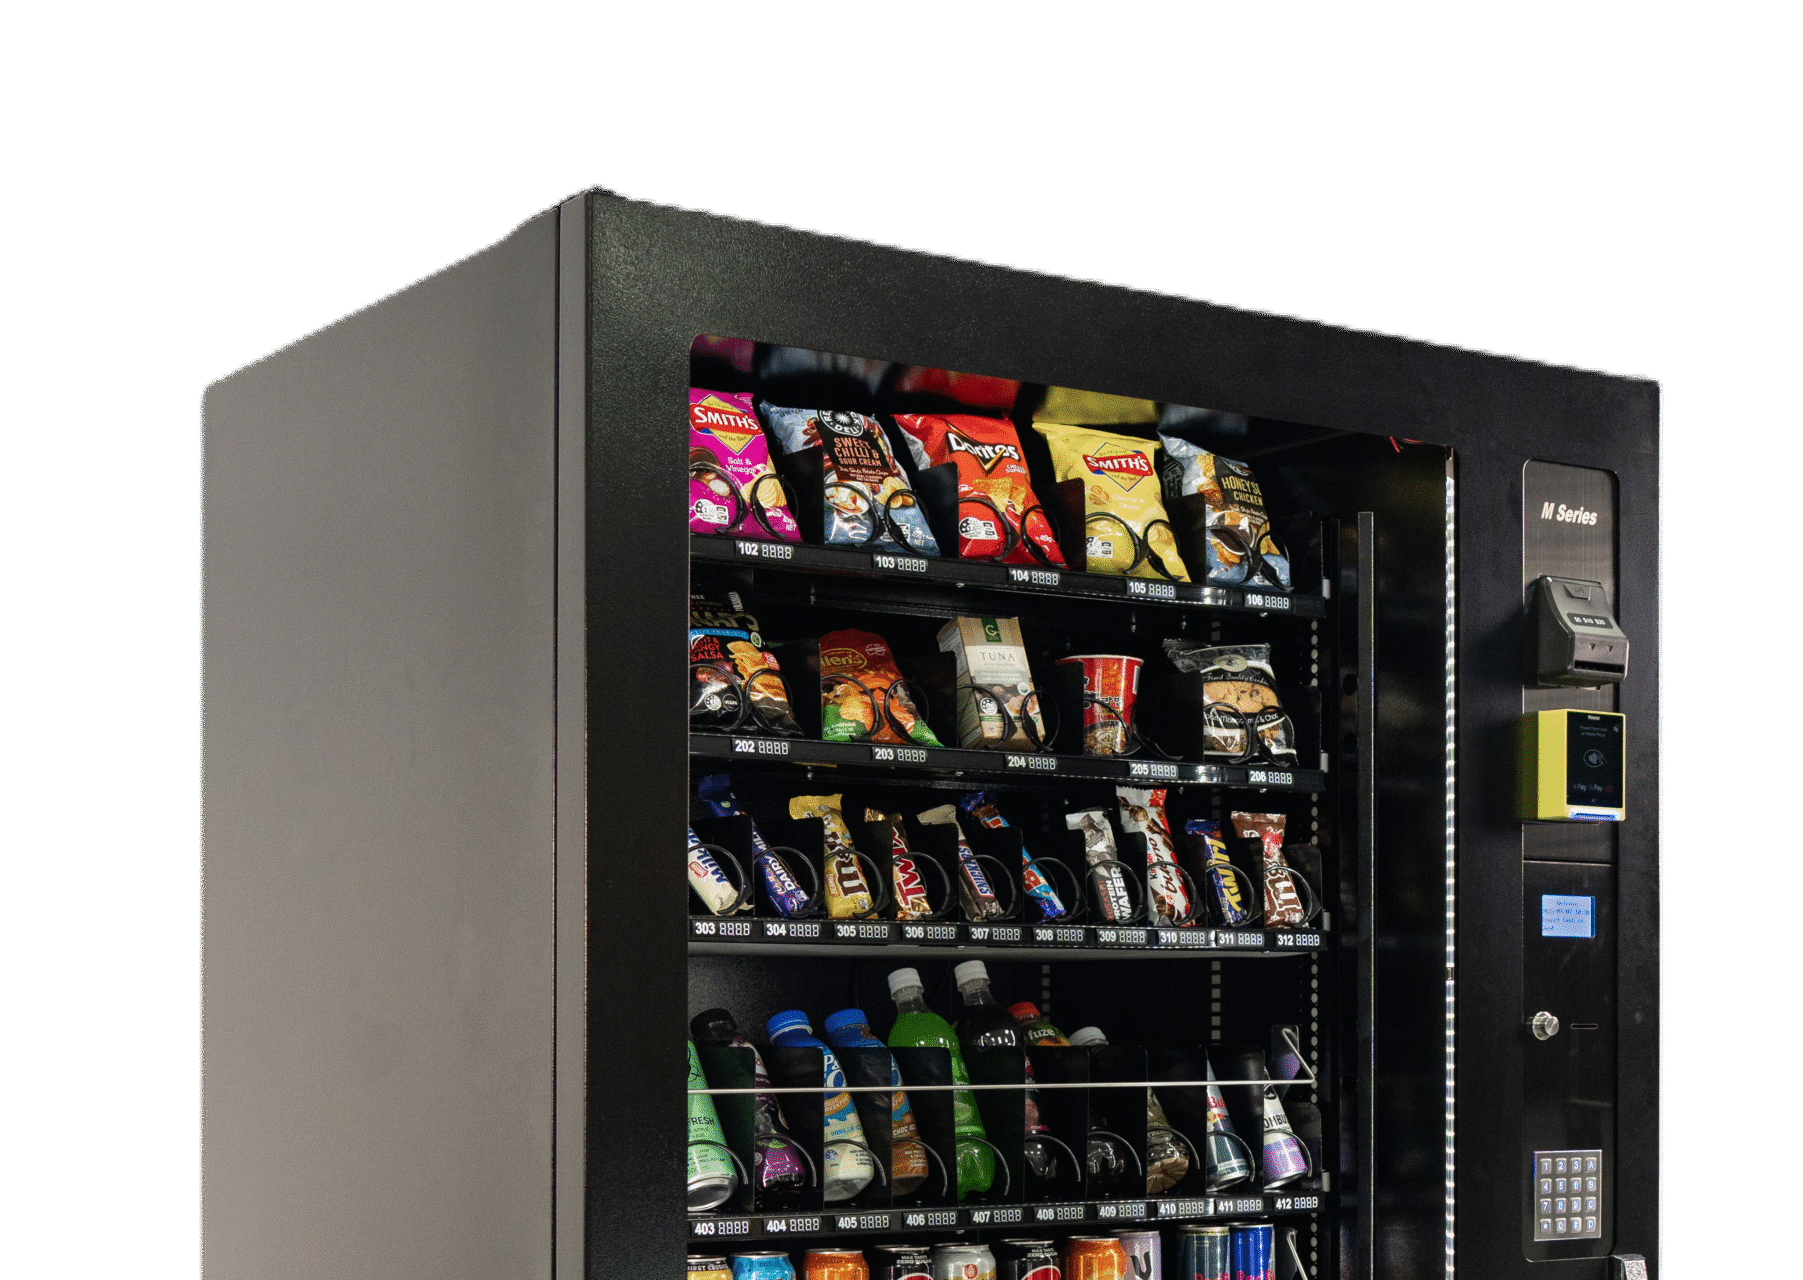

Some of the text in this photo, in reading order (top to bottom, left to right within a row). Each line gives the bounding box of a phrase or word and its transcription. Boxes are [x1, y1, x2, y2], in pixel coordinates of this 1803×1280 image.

[694, 407, 758, 430] SMITH'S
[833, 437, 871, 449] SWEET
[948, 432, 1020, 460] Doritos
[834, 447, 880, 459] CHILLI &
[838, 457, 882, 466] SOUR CREAM
[1087, 456, 1149, 471] SMITH'S
[1221, 475, 1251, 493] HONEY
[1233, 491, 1264, 506] CHICKEN
[1541, 501, 1598, 526] M Series
[739, 542, 758, 555] 102
[876, 556, 894, 568] 103
[1012, 570, 1029, 581] 104
[1129, 582, 1147, 594] 105
[1247, 595, 1263, 606] 106
[980, 652, 1016, 661] TUNA
[735, 740, 755, 752] 202
[875, 748, 894, 760] 203
[1008, 756, 1026, 767] 204
[1132, 764, 1149, 776] 205
[1250, 771, 1266, 782] 206
[764, 855, 796, 890] DAIRY
[1110, 864, 1132, 921] WAFER
[1105, 880, 1121, 920] PROTEIN
[696, 922, 715, 934] 303
[767, 924, 786, 935] 304
[837, 925, 856, 936] 305
[905, 927, 924, 938] 306
[972, 928, 989, 939] 307
[1036, 929, 1053, 940] 308
[1100, 931, 1116, 941] 309
[1160, 932, 1177, 942] 310
[1219, 934, 1234, 944] 311
[1278, 935, 1293, 945] 312
[1028, 1028, 1055, 1040] fuze
[1160, 1203, 1177, 1215] 410
[1219, 1201, 1233, 1211] 411
[1276, 1199, 1291, 1209] 412
[973, 1211, 990, 1222] 407
[1037, 1209, 1054, 1220] 408
[1100, 1206, 1116, 1217] 409
[839, 1217, 857, 1228] 405
[907, 1214, 925, 1225] 406
[695, 1223, 715, 1234] 403
[767, 1220, 786, 1231] 404
